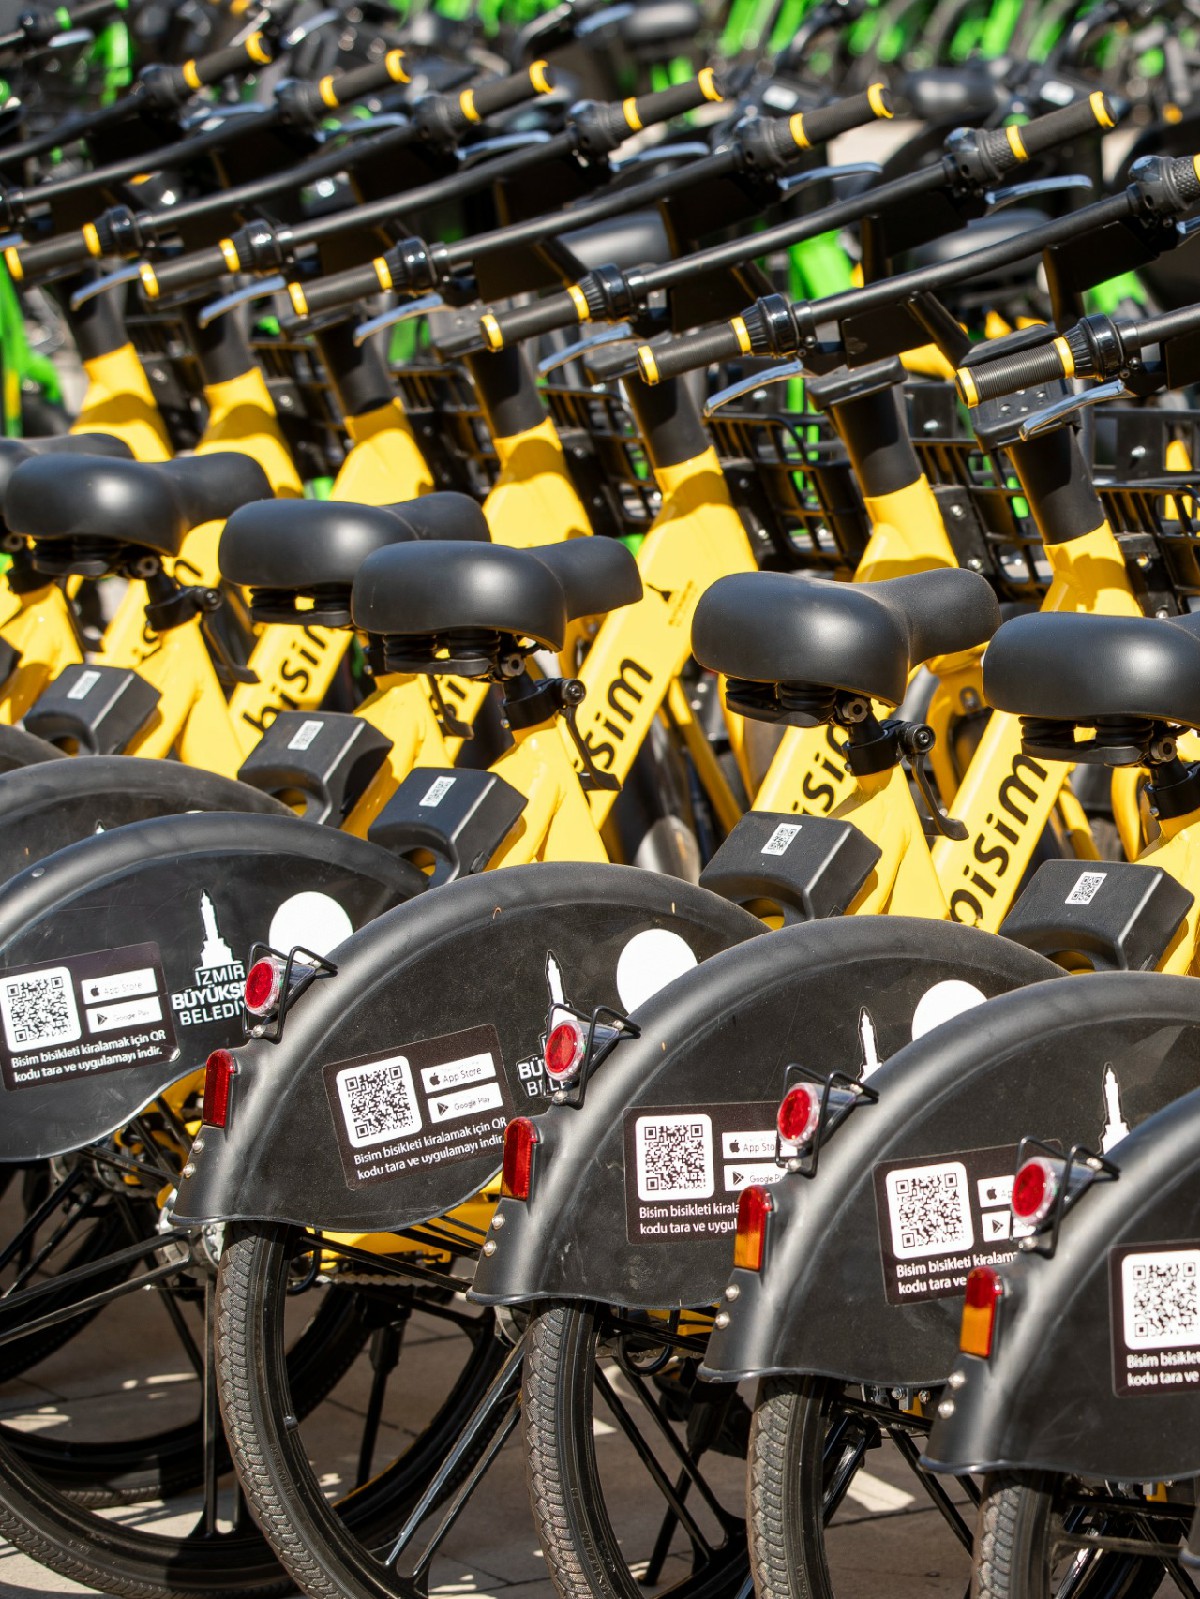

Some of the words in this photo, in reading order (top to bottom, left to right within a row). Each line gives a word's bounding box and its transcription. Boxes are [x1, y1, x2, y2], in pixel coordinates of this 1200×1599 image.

[11, 1054, 40, 1069] Bisim
[40, 1044, 81, 1063] bisikleti
[81, 1036, 130, 1055] kiralamak
[130, 1033, 149, 1047] için
[149, 1029, 167, 1041] QR
[13, 1069, 41, 1083] kodu
[41, 1065, 63, 1077] tara
[63, 1062, 77, 1073] ve
[77, 1053, 137, 1072] uygulamayı
[137, 1045, 163, 1059] indir.
[460, 1067, 482, 1080] Store
[353, 1151, 382, 1166] Bisim
[382, 1138, 423, 1159] bisikleti
[423, 1126, 473, 1147] kiralamak
[472, 1122, 491, 1137] için
[491, 1116, 507, 1130] QR
[743, 1143, 760, 1154] App
[356, 1165, 384, 1181] kodu
[384, 1159, 406, 1174] tara
[406, 1156, 420, 1167] ve
[421, 1144, 479, 1165] uygulamayı
[639, 1206, 669, 1219] Bisim
[670, 1203, 712, 1218] bisikleti
[640, 1222, 668, 1235] kodu
[669, 1222, 691, 1234] tara
[692, 1221, 706, 1232] ve
[707, 1218, 738, 1234] uygul
[896, 1263, 927, 1279] Bisim
[928, 1256, 972, 1274] bisikleti
[898, 1279, 927, 1294] kodu
[928, 1276, 952, 1291] tara
[952, 1276, 967, 1287] ve
[1126, 1353, 1160, 1369] Bisim
[1127, 1371, 1159, 1387] kodu
[1159, 1371, 1183, 1384] tara
[1183, 1370, 1200, 1383] ve
